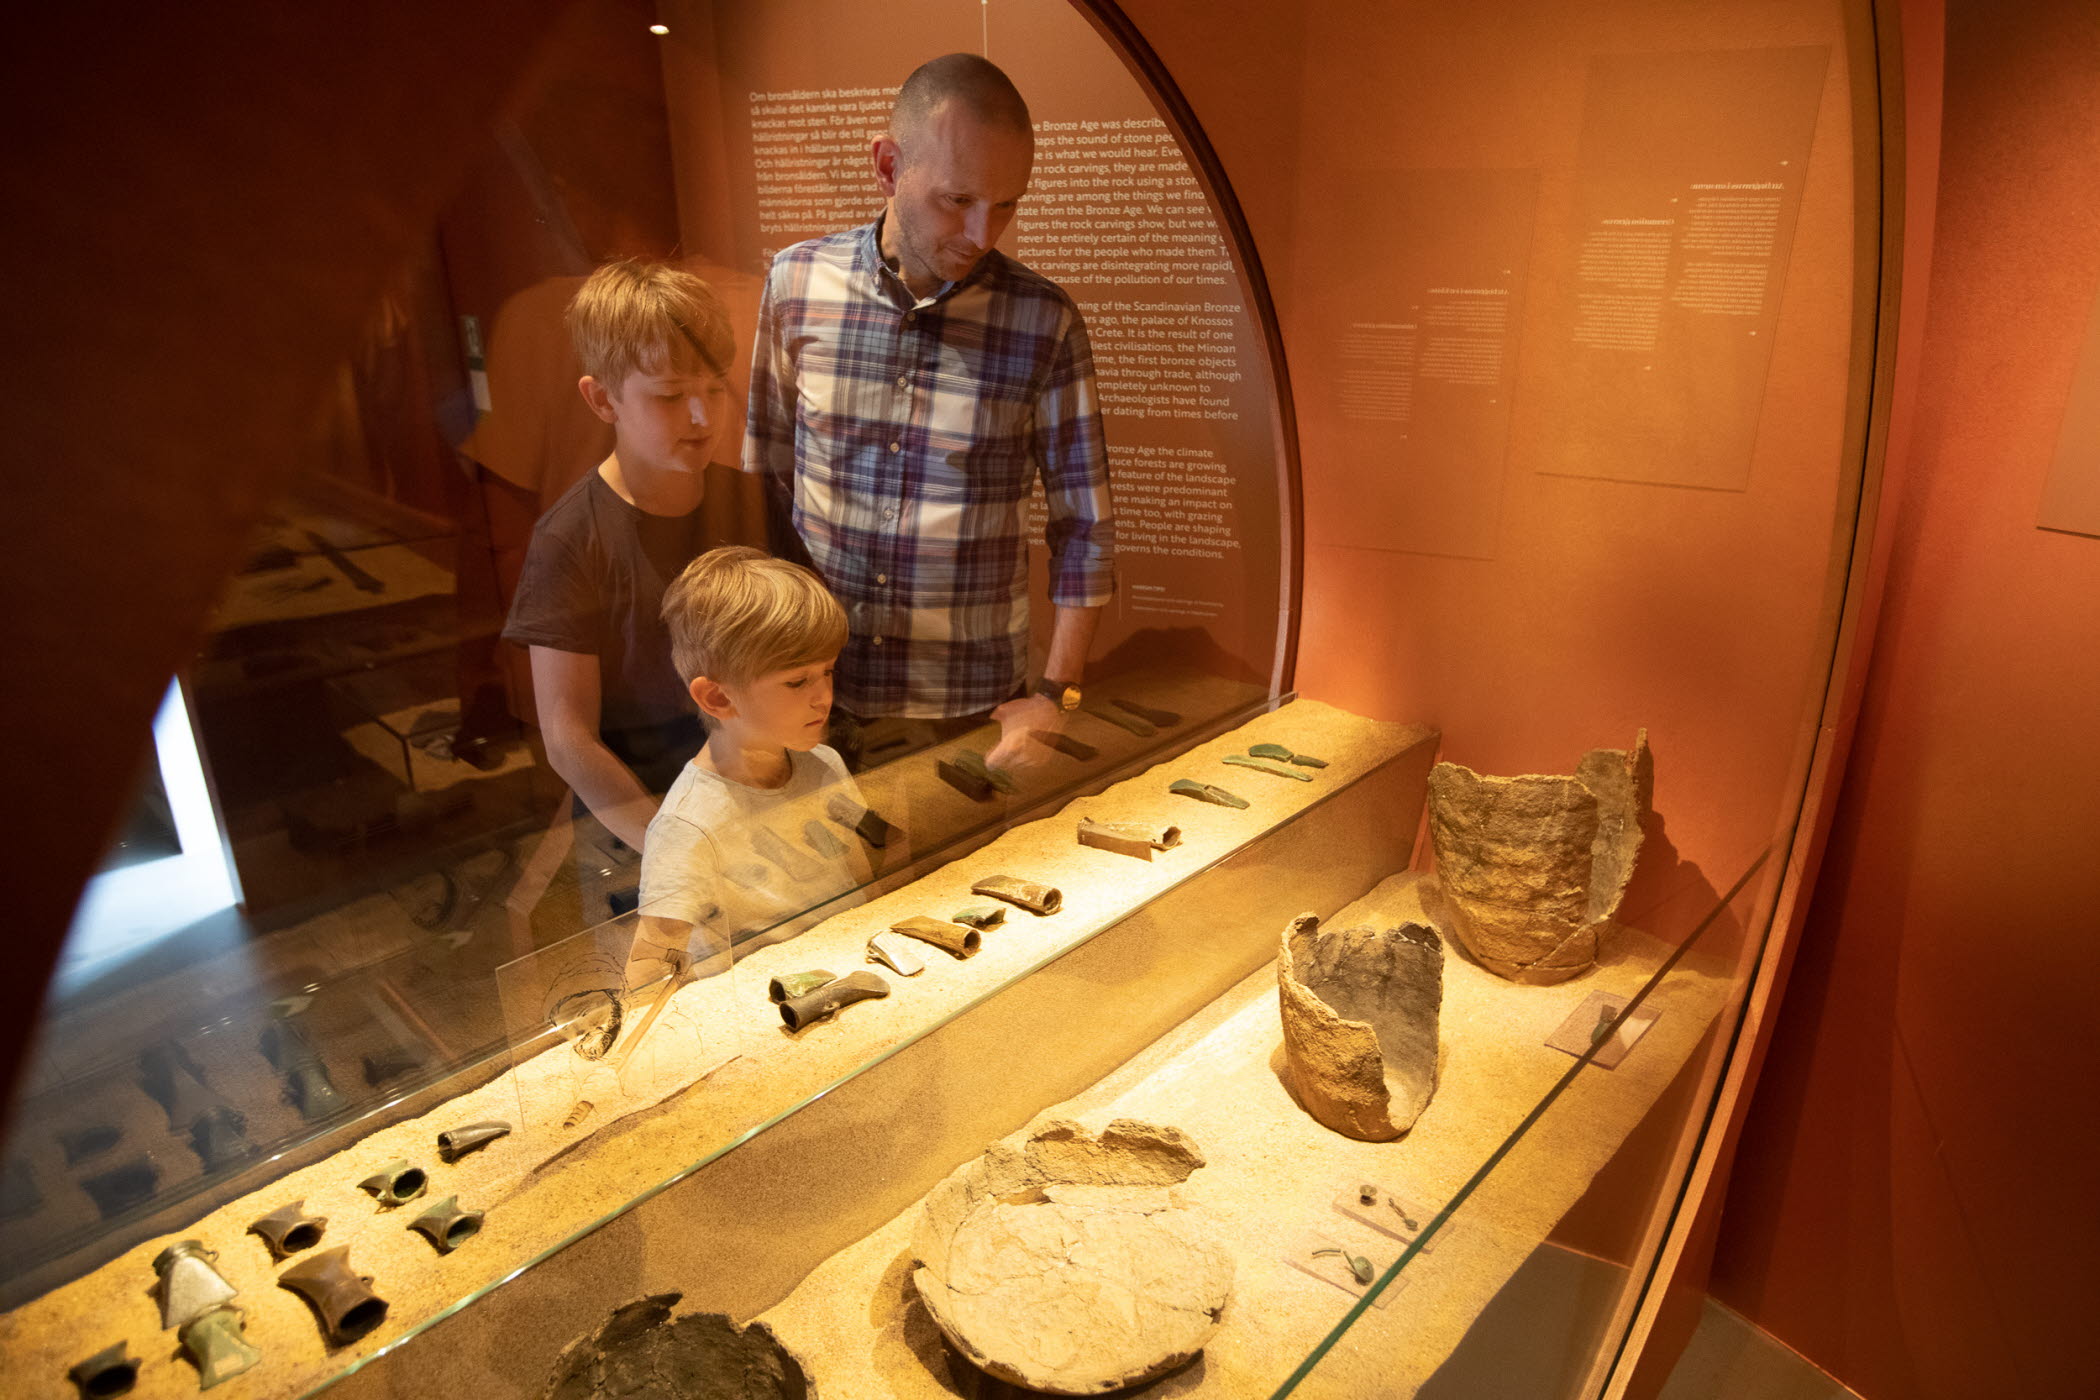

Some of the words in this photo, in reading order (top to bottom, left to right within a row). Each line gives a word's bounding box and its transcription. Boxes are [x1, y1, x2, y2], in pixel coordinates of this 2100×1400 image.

[1043, 121, 1077, 131] Bronze
[1080, 121, 1099, 132] Age
[1102, 120, 1120, 129] was
[1058, 136, 1074, 145] the
[1077, 135, 1107, 144] sound
[1111, 134, 1122, 143] of
[1124, 134, 1152, 143] stone
[1046, 150, 1053, 159] is
[1055, 150, 1080, 159] what
[1100, 148, 1131, 158] would
[1134, 148, 1159, 157] hear.
[1044, 164, 1066, 173] rock
[1068, 164, 1110, 175] carvings,
[1114, 163, 1136, 173] they
[1158, 161, 1187, 171] made
[1035, 179, 1068, 189] figures
[1070, 178, 1090, 187] into
[1093, 178, 1109, 186] the
[1112, 177, 1134, 186] rock
[1137, 177, 1164, 188] using
[1077, 194, 1111, 204] among
[1114, 192, 1130, 200] the
[1133, 191, 1164, 202] things
[1017, 207, 1038, 216] date
[1041, 206, 1064, 215] from
[1067, 206, 1083, 215] the
[1086, 205, 1120, 215] Bronze
[1123, 205, 1144, 216] Age.
[1147, 205, 1163, 214] We
[1166, 206, 1184, 214] can
[1017, 220, 1049, 231] figures
[1052, 220, 1068, 229] the
[1070, 220, 1092, 229] rock
[1095, 219, 1135, 230] carvings
[1138, 220, 1165, 229] show,
[1169, 219, 1186, 228] but
[1046, 234, 1059, 243] be
[1061, 234, 1099, 245] entirely
[1101, 234, 1136, 243] certain
[1139, 233, 1149, 242] of
[1152, 233, 1169, 242] the
[1172, 233, 1217, 244] meaning
[1018, 249, 1056, 258] pictures
[1059, 247, 1072, 256] for
[1075, 248, 1091, 256] the
[1094, 247, 1129, 258] people
[1131, 247, 1152, 256] who
[1156, 247, 1185, 256] made
[1188, 247, 1216, 256] them.
[1041, 261, 1080, 272] carvings
[1083, 262, 1098, 270] are
[1101, 261, 1170, 272] disintegrating
[1202, 261, 1235, 272] rapidl
[1083, 275, 1094, 283] of
[1095, 275, 1112, 283] the
[1114, 274, 1160, 286] pollution
[1163, 275, 1174, 283] of
[1196, 275, 1227, 284] times.
[1102, 302, 1112, 310] of
[1115, 302, 1131, 311] the
[1134, 302, 1200, 312] Scandinavian
[1204, 304, 1240, 312] Bronze
[1100, 317, 1118, 326] ago,
[1122, 316, 1139, 324] the
[1141, 316, 1174, 326] palace
[1178, 316, 1189, 325] of
[1191, 316, 1233, 326] Knossos
[1095, 328, 1124, 337] Crete.
[1128, 329, 1135, 337] It
[1149, 330, 1165, 338] the
[1168, 329, 1197, 339] result
[1200, 330, 1211, 339] of
[1114, 342, 1174, 352] civilisations,
[1178, 343, 1194, 352] the
[1198, 344, 1235, 353] Minoan
[1119, 355, 1135, 363] the
[1139, 356, 1158, 365] first
[1161, 356, 1194, 365] bronze
[1198, 357, 1236, 367] objects
[1122, 369, 1162, 379] through
[1164, 370, 1192, 379] trade,
[1196, 371, 1241, 381] although
[1098, 381, 1147, 392] ompletely
[1150, 382, 1196, 392] unknown
[1200, 383, 1210, 392] to
[1173, 396, 1196, 405] have
[1200, 396, 1229, 406] found
[1114, 407, 1145, 417] dating
[1148, 408, 1171, 416] from
[1174, 409, 1201, 418] times
[1205, 410, 1238, 420] before
[1138, 446, 1155, 456] Age
[1158, 447, 1174, 456] the
[1177, 448, 1214, 458] climate
[1135, 458, 1166, 468] forests
[1187, 461, 1227, 472] growing
[1118, 470, 1153, 480] feature
[1155, 471, 1165, 480] of
[1168, 472, 1183, 482] the
[1186, 473, 1237, 485] landscape
[1138, 485, 1161, 493] were
[1163, 484, 1228, 497] predominant
[1114, 496, 1128, 504] are
[1131, 495, 1166, 507] making
[1169, 498, 1180, 506] an
[1183, 498, 1217, 510] impact
[1220, 500, 1232, 509] on
[1120, 507, 1141, 516] time
[1164, 509, 1185, 519] with
[1188, 512, 1223, 523] grazing
[1140, 520, 1172, 531] People
[1175, 523, 1190, 531] are
[1192, 523, 1231, 536] shaping
[1116, 530, 1129, 540] for
[1132, 531, 1157, 544] living
[1159, 534, 1168, 542] in
[1171, 533, 1187, 543] the
[1114, 543, 1150, 554] governs
[1153, 545, 1169, 554] the
[1171, 546, 1224, 559] conditions.
